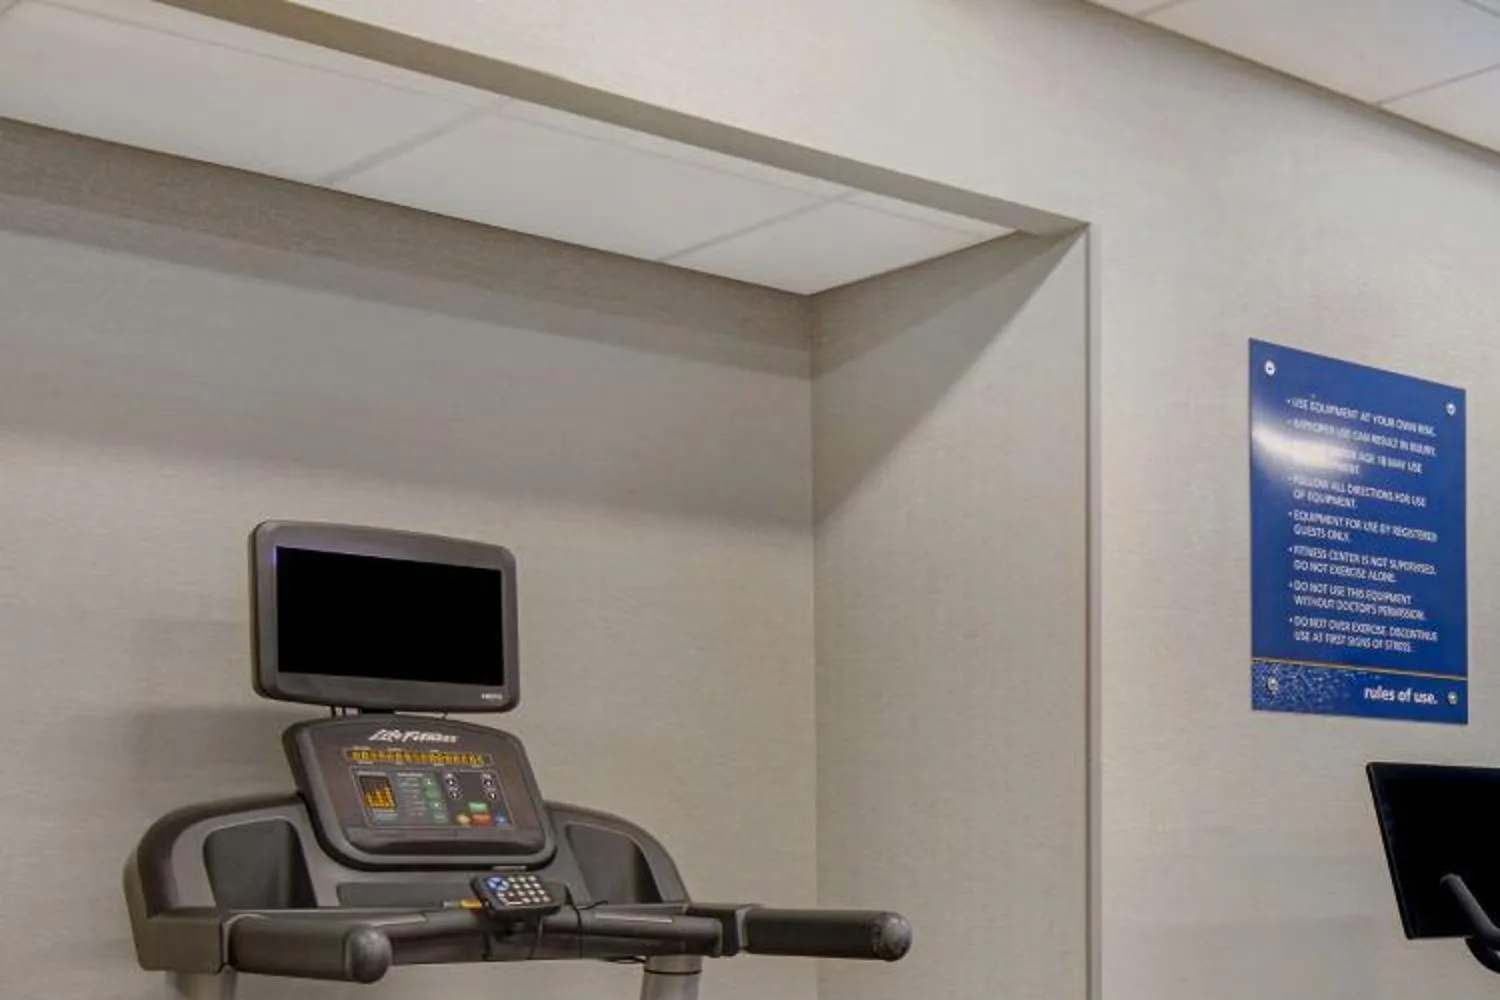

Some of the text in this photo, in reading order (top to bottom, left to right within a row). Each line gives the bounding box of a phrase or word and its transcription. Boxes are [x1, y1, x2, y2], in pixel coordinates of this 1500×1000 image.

[1310, 400, 1359, 420] EQUIPMENT
[1360, 412, 1370, 423] AT
[1373, 415, 1395, 428] YOUR
[1396, 420, 1416, 433] OWN
[1407, 461, 1423, 474] USE
[1293, 488, 1305, 500] OF
[1348, 485, 1393, 501] DIRECTIONS
[1395, 493, 1410, 504] FOR
[1412, 496, 1427, 507] USE
[1293, 510, 1438, 542] EQUIPMENT FOR USE BY REGISTERED
[1293, 524, 1326, 538] GUESTS
[1294, 545, 1326, 558] FITNESS
[1328, 550, 1361, 564] CENTER
[1362, 555, 1369, 565] IS
[1371, 556, 1388, 568] NOT
[1293, 560, 1307, 571] DO
[1309, 562, 1327, 573] NOT
[1330, 565, 1367, 579] EXERCISE
[1293, 580, 1412, 605] DO NOT USE THIS EQUIPMENT
[1294, 595, 1334, 609] WITHOUT
[1294, 616, 1308, 627] DO
[1310, 618, 1327, 629] NOT
[1328, 620, 1350, 632] OVER
[1294, 631, 1309, 641] USE
[1325, 634, 1346, 645] FIRST
[1364, 685, 1439, 705] rules of use.
